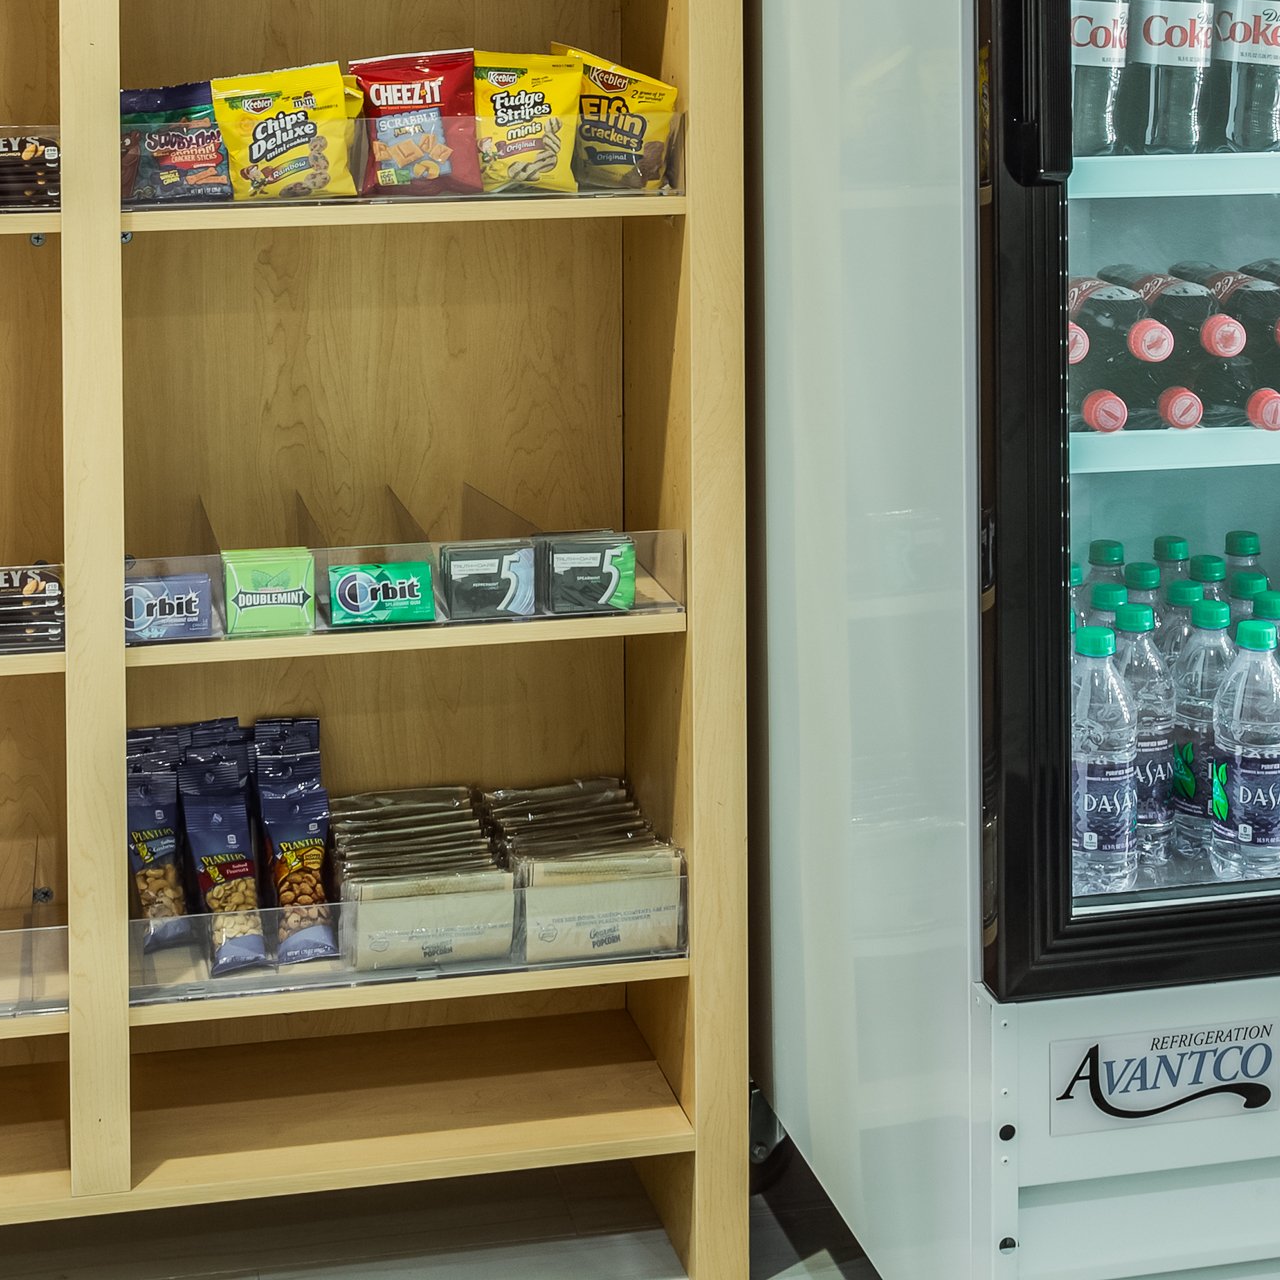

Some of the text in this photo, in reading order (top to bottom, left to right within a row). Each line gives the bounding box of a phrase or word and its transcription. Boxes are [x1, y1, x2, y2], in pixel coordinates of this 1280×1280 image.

[489, 72, 517, 84] Keebler
[591, 68, 629, 91] Keebler
[243, 99, 272, 111] Keebler
[493, 91, 544, 110] Fudge
[496, 103, 550, 125] Stripes
[581, 98, 643, 135] Elfin
[256, 111, 305, 141] Chips
[507, 124, 541, 140] minis
[583, 124, 638, 148] Crackers
[252, 123, 314, 160] Deluxe
[507, 140, 536, 152] Original
[273, 160, 306, 179] Rainbow
[497, 553, 519, 610] 5
[598, 549, 623, 604] 5
[238, 590, 305, 606] DOUBLEMINT
[201, 854, 246, 865] PLANTERS
[1150, 1024, 1273, 1051] REFRIGERATION
[1056, 1043, 1272, 1118] AVANTCO
